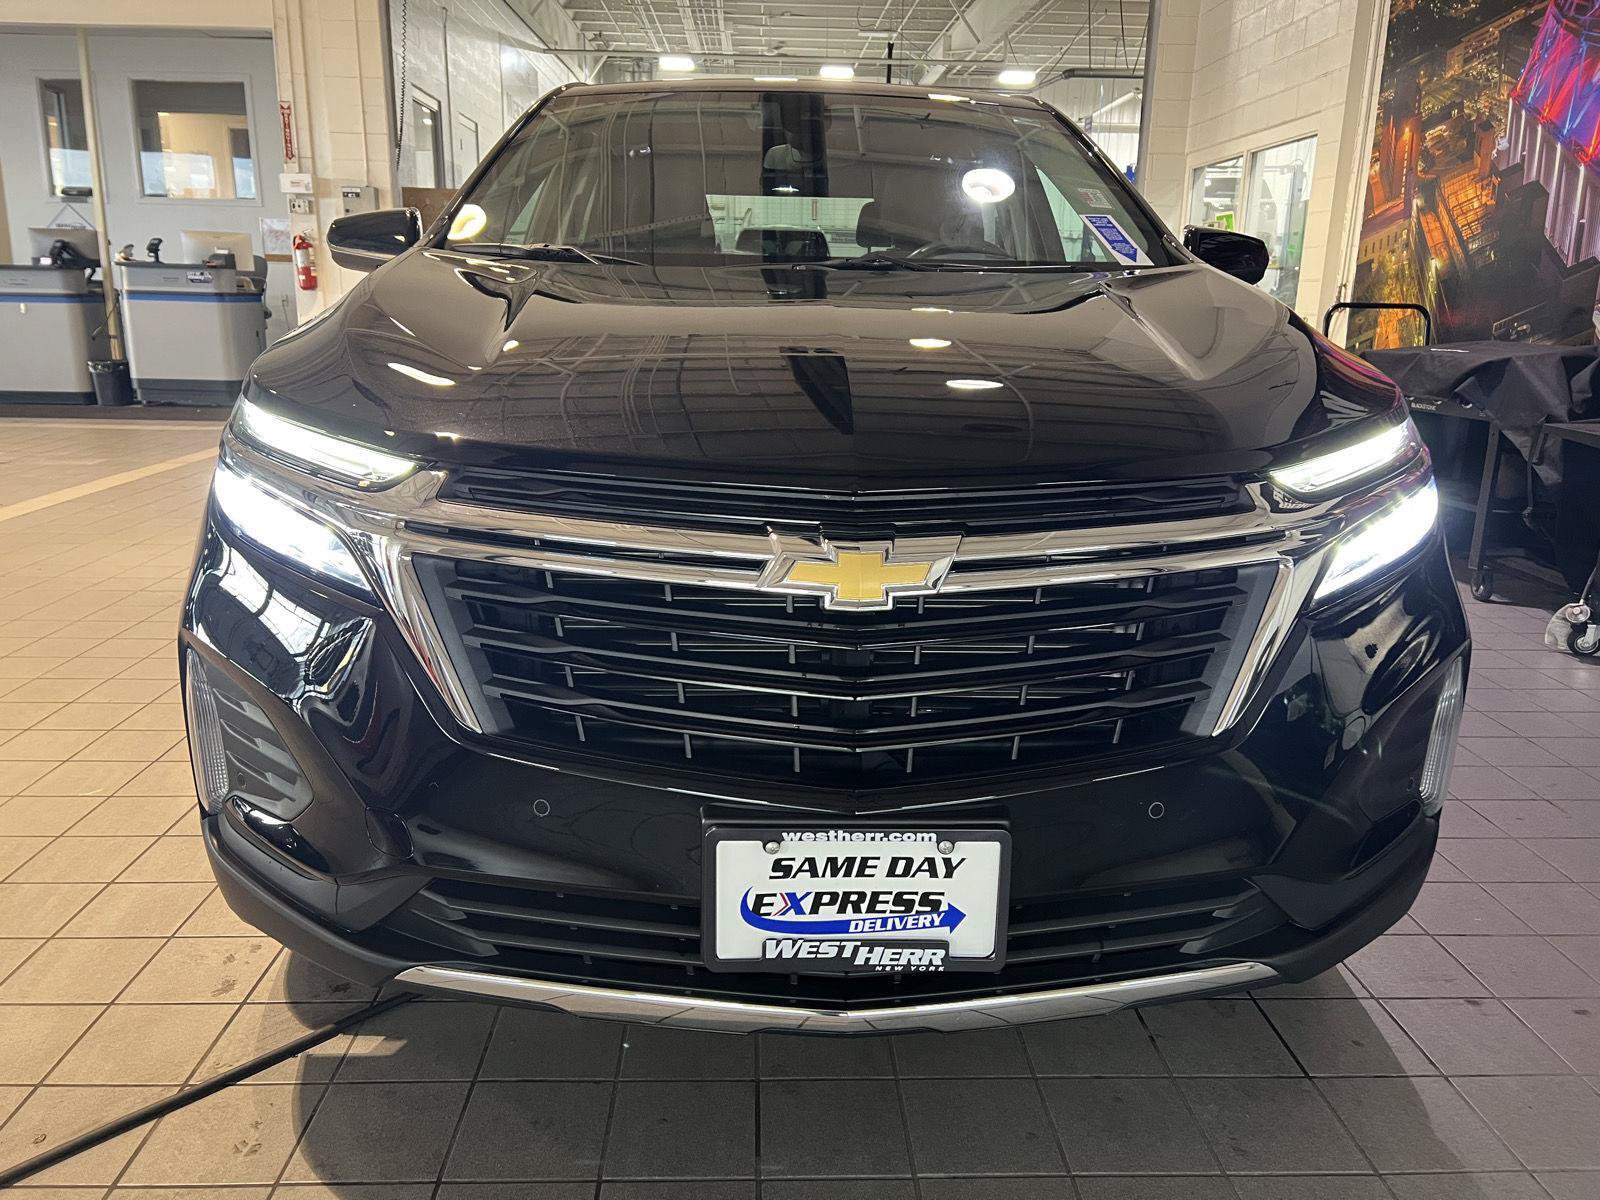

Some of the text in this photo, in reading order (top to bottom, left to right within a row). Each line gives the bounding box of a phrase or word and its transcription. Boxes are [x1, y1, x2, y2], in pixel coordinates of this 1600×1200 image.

[1410, 402, 1437, 411] BLACKSTONE
[782, 830, 937, 842] westherr.com
[768, 856, 967, 880] SAME DAY
[751, 891, 946, 916] EXPRESS
[848, 912, 946, 933] DELIVERY
